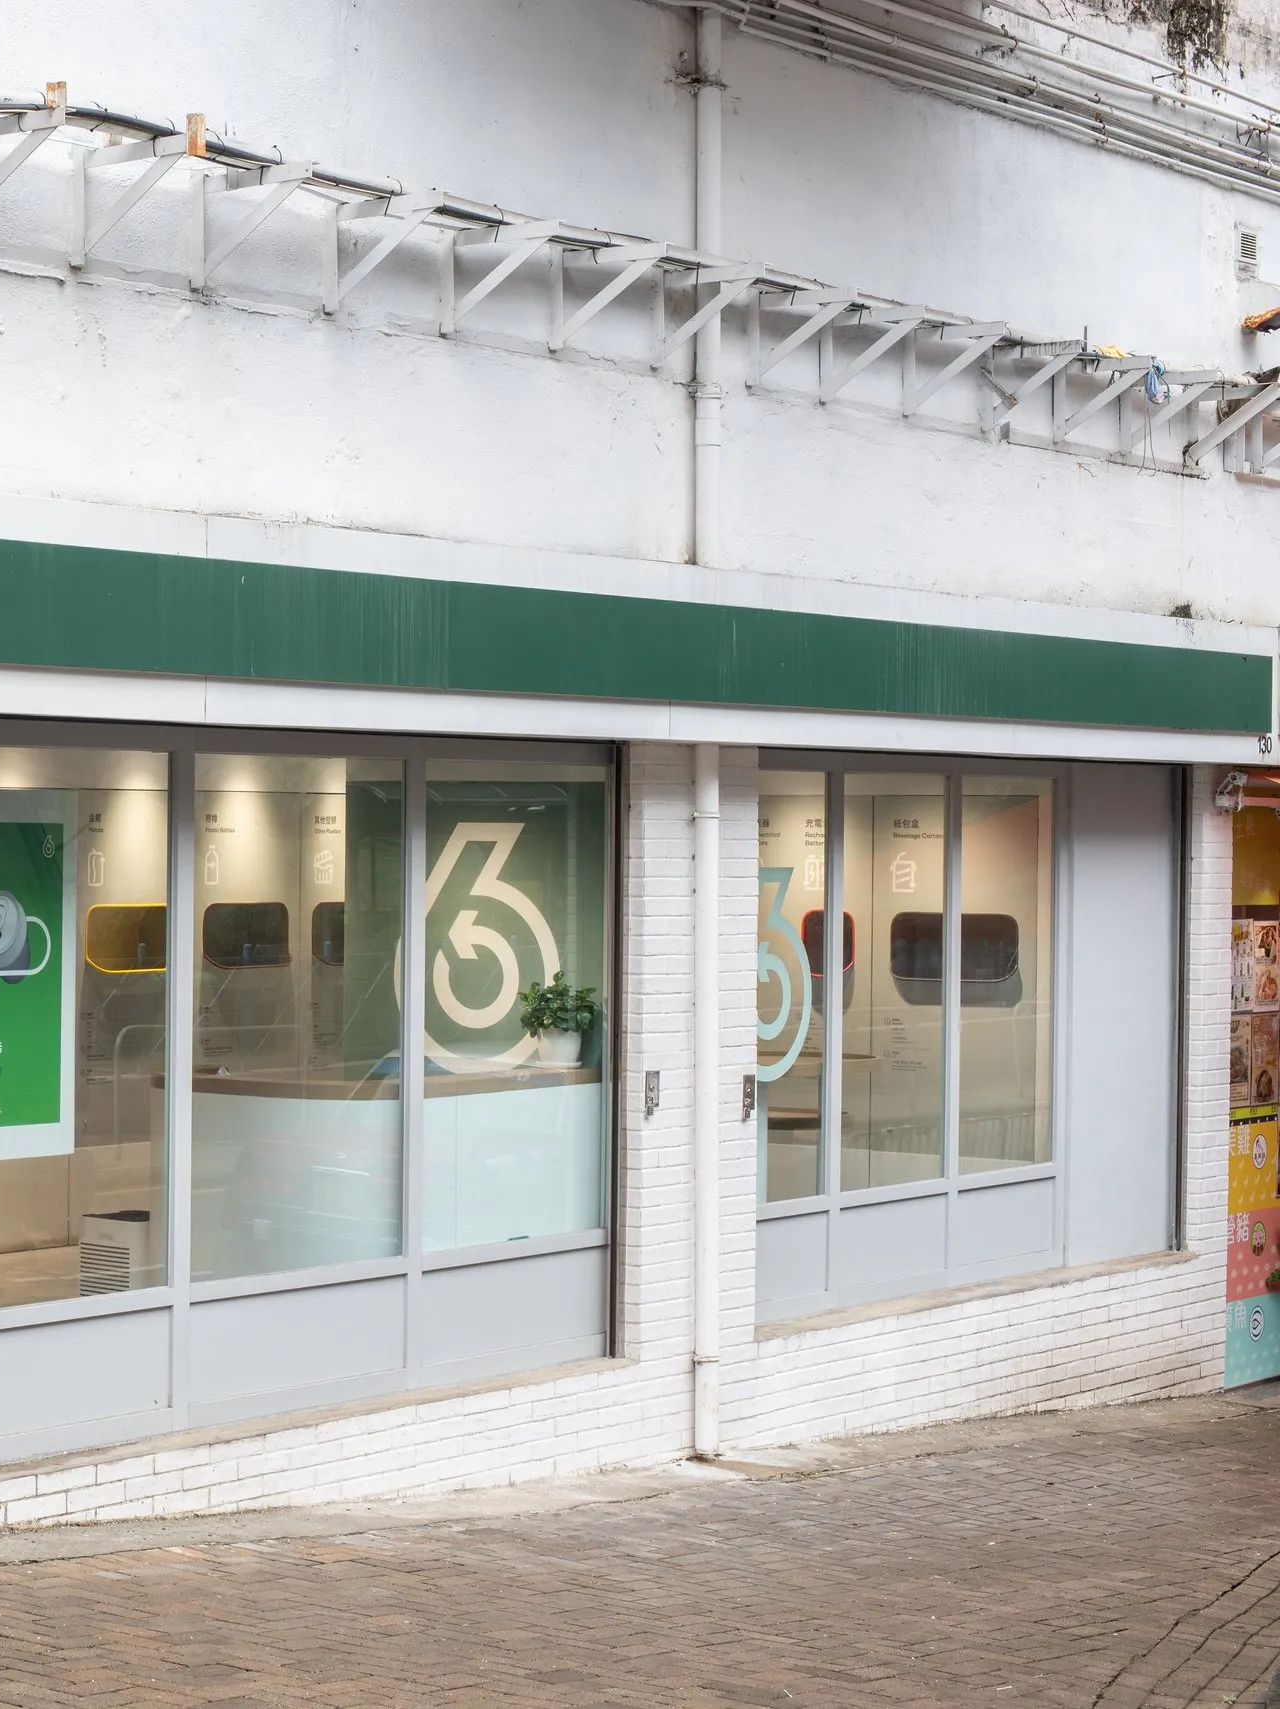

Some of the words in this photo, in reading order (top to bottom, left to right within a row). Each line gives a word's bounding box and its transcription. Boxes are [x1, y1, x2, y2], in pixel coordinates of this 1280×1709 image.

[1257, 735, 1272, 754] 130
[893, 818, 920, 829] 紙包盒
[893, 832, 921, 840] Beverage
